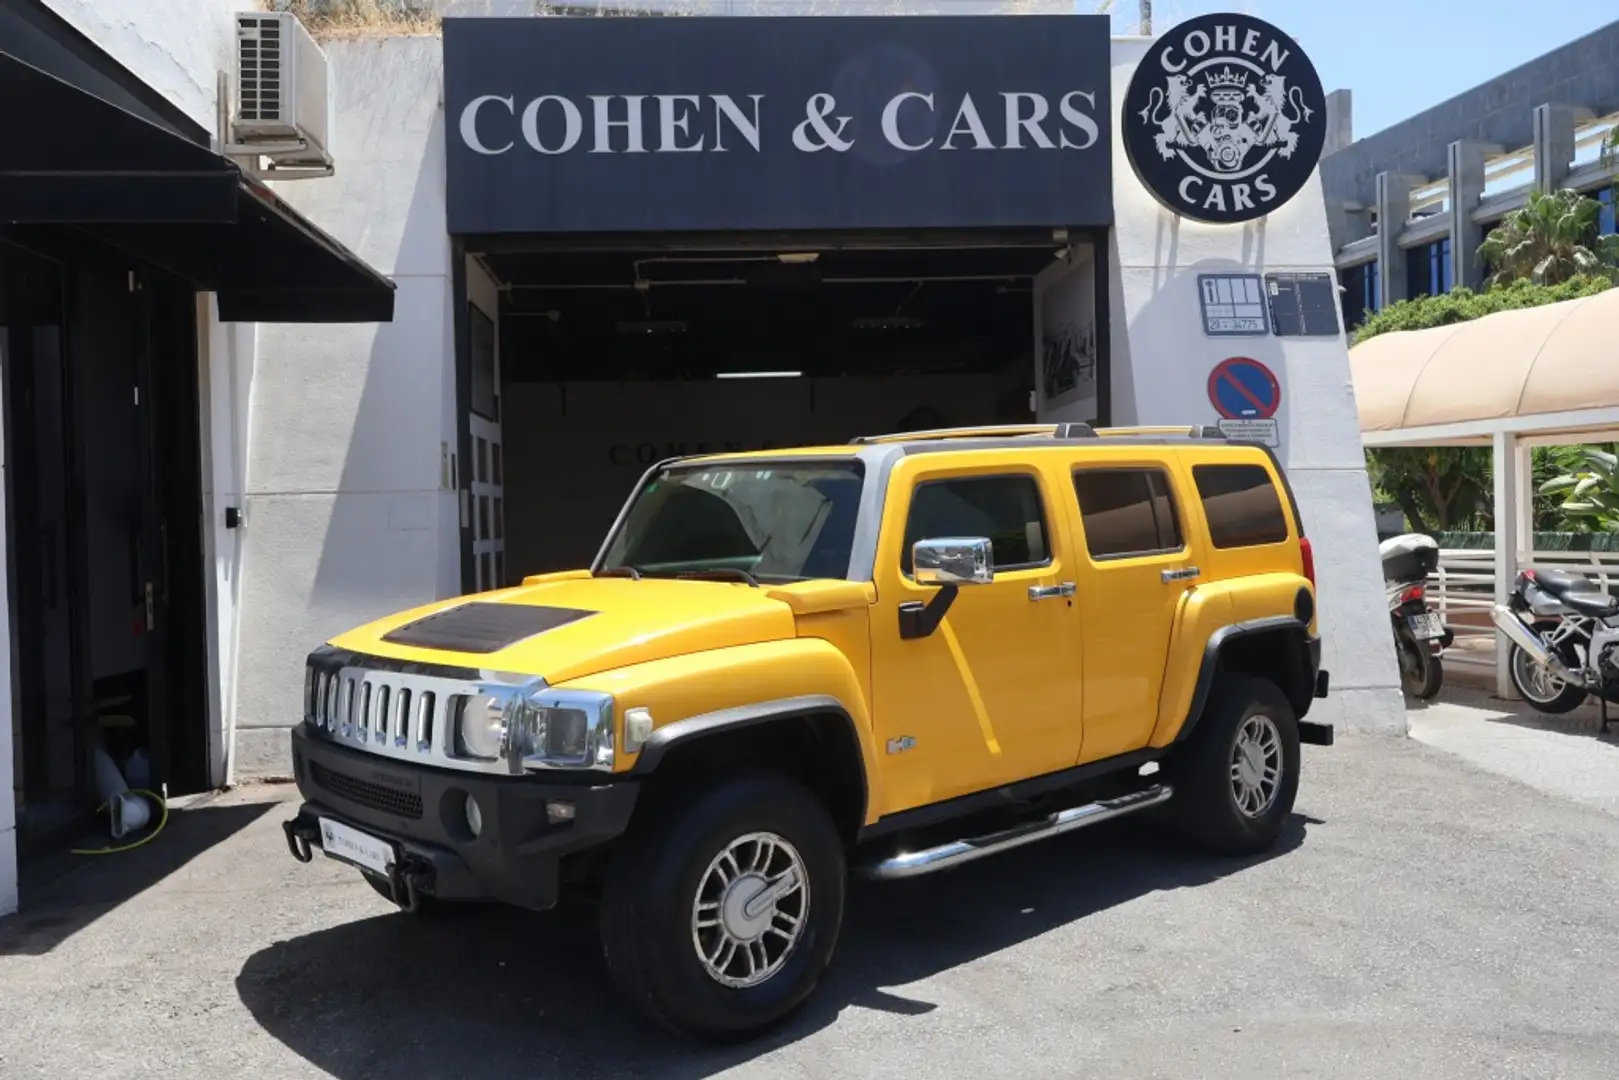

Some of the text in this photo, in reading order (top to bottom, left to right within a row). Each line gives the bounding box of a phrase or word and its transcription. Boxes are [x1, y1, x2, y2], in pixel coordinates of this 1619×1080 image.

[1160, 25, 1290, 73] COHEN
[458, 90, 1099, 155] COHEN & CARS
[1178, 174, 1277, 212] CARS
